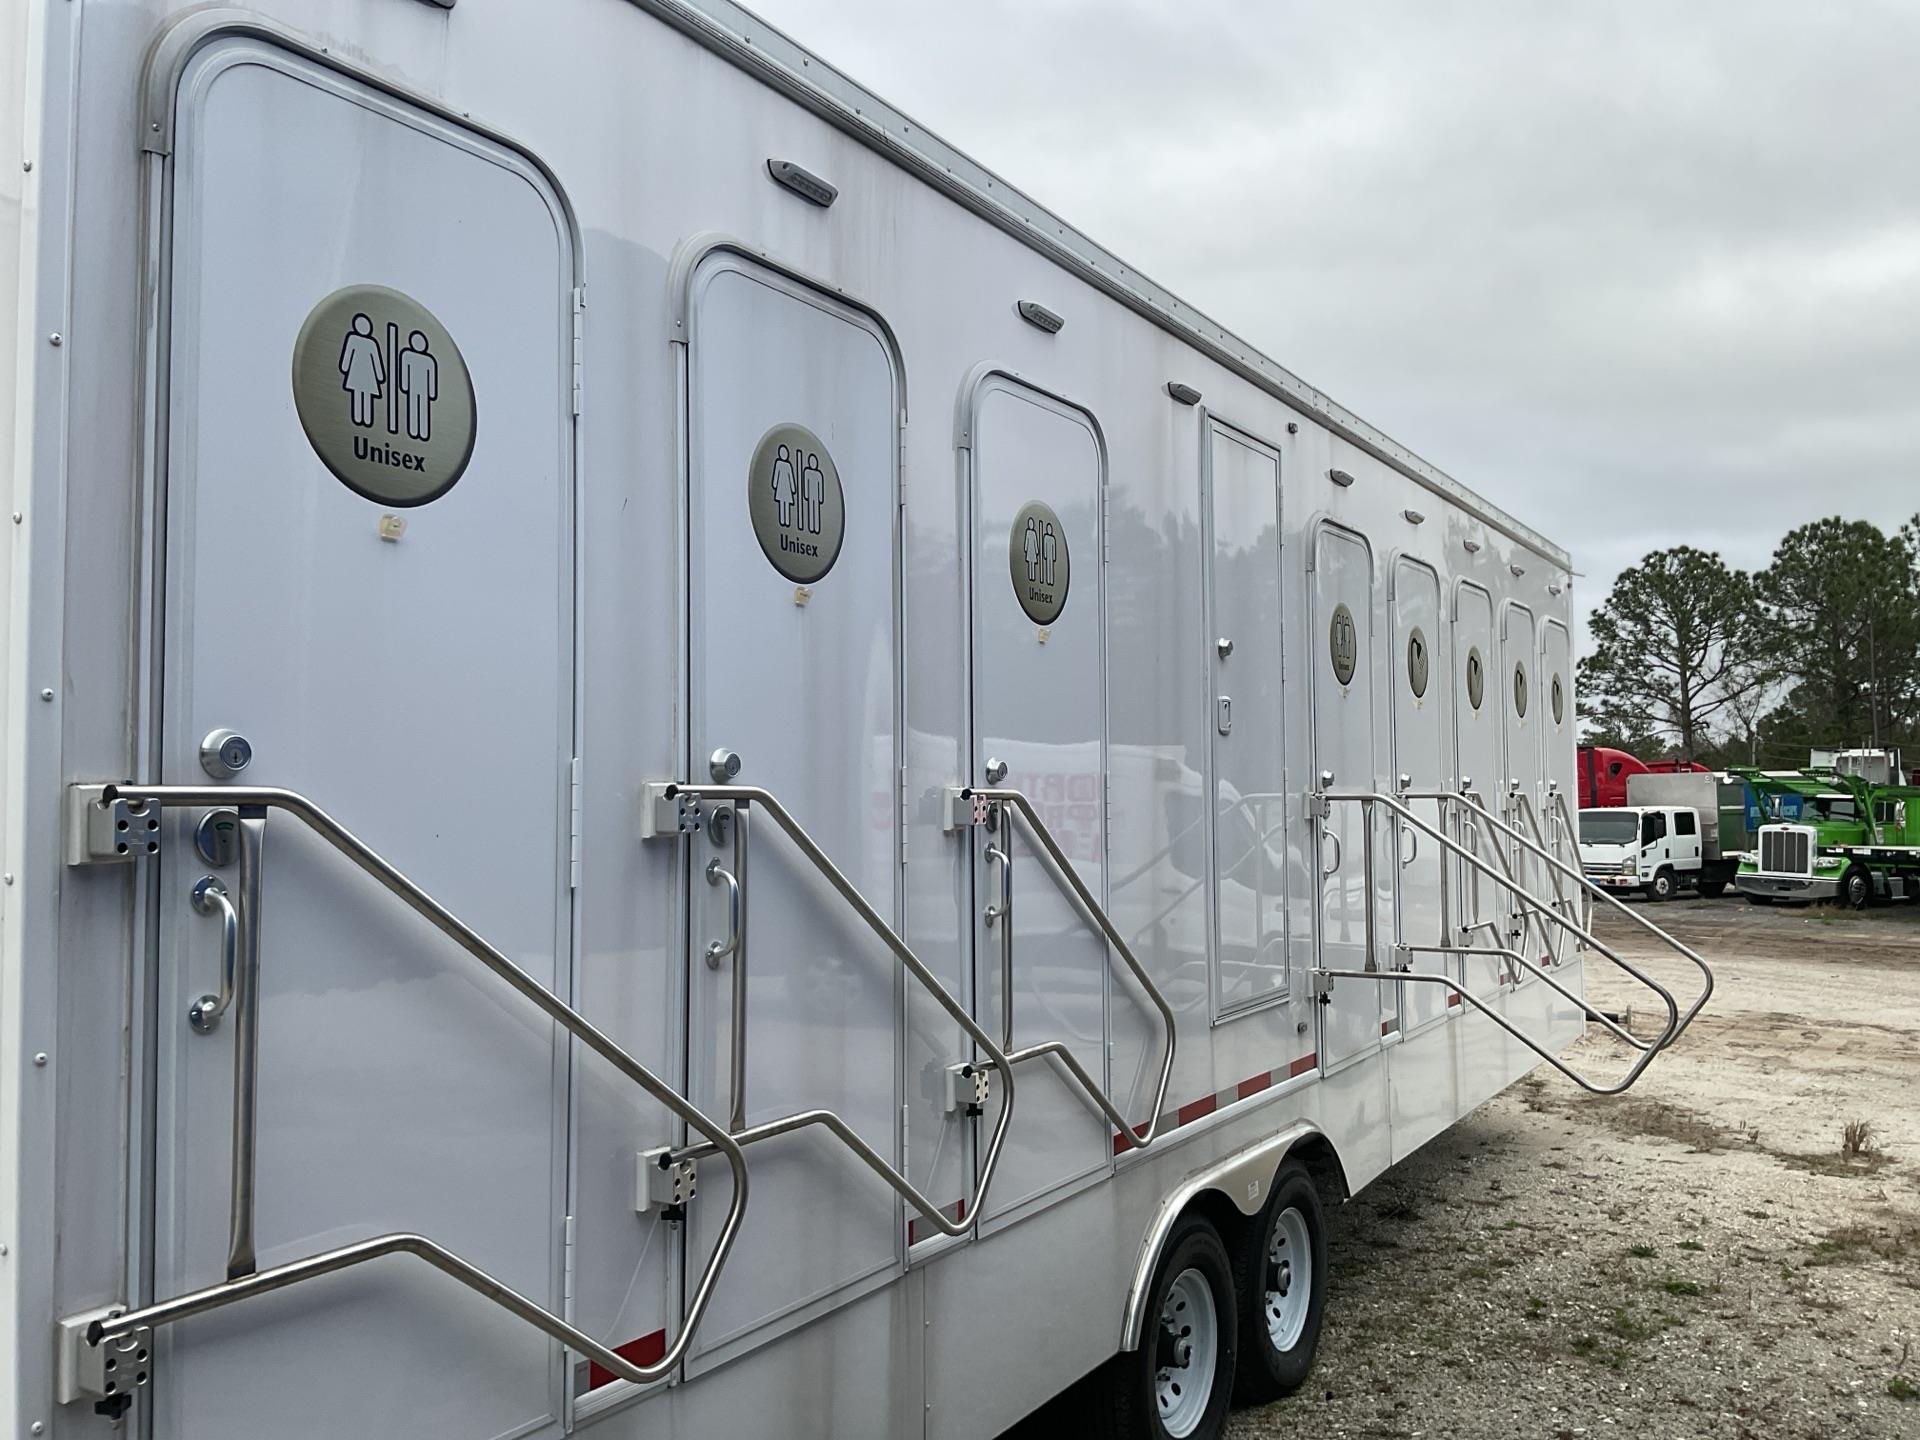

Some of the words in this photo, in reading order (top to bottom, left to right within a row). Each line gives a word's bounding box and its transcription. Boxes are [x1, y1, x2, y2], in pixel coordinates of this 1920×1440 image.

[353, 435, 426, 473] Unisex
[780, 533, 818, 558] Unisex
[1029, 586, 1053, 604] Unisex
